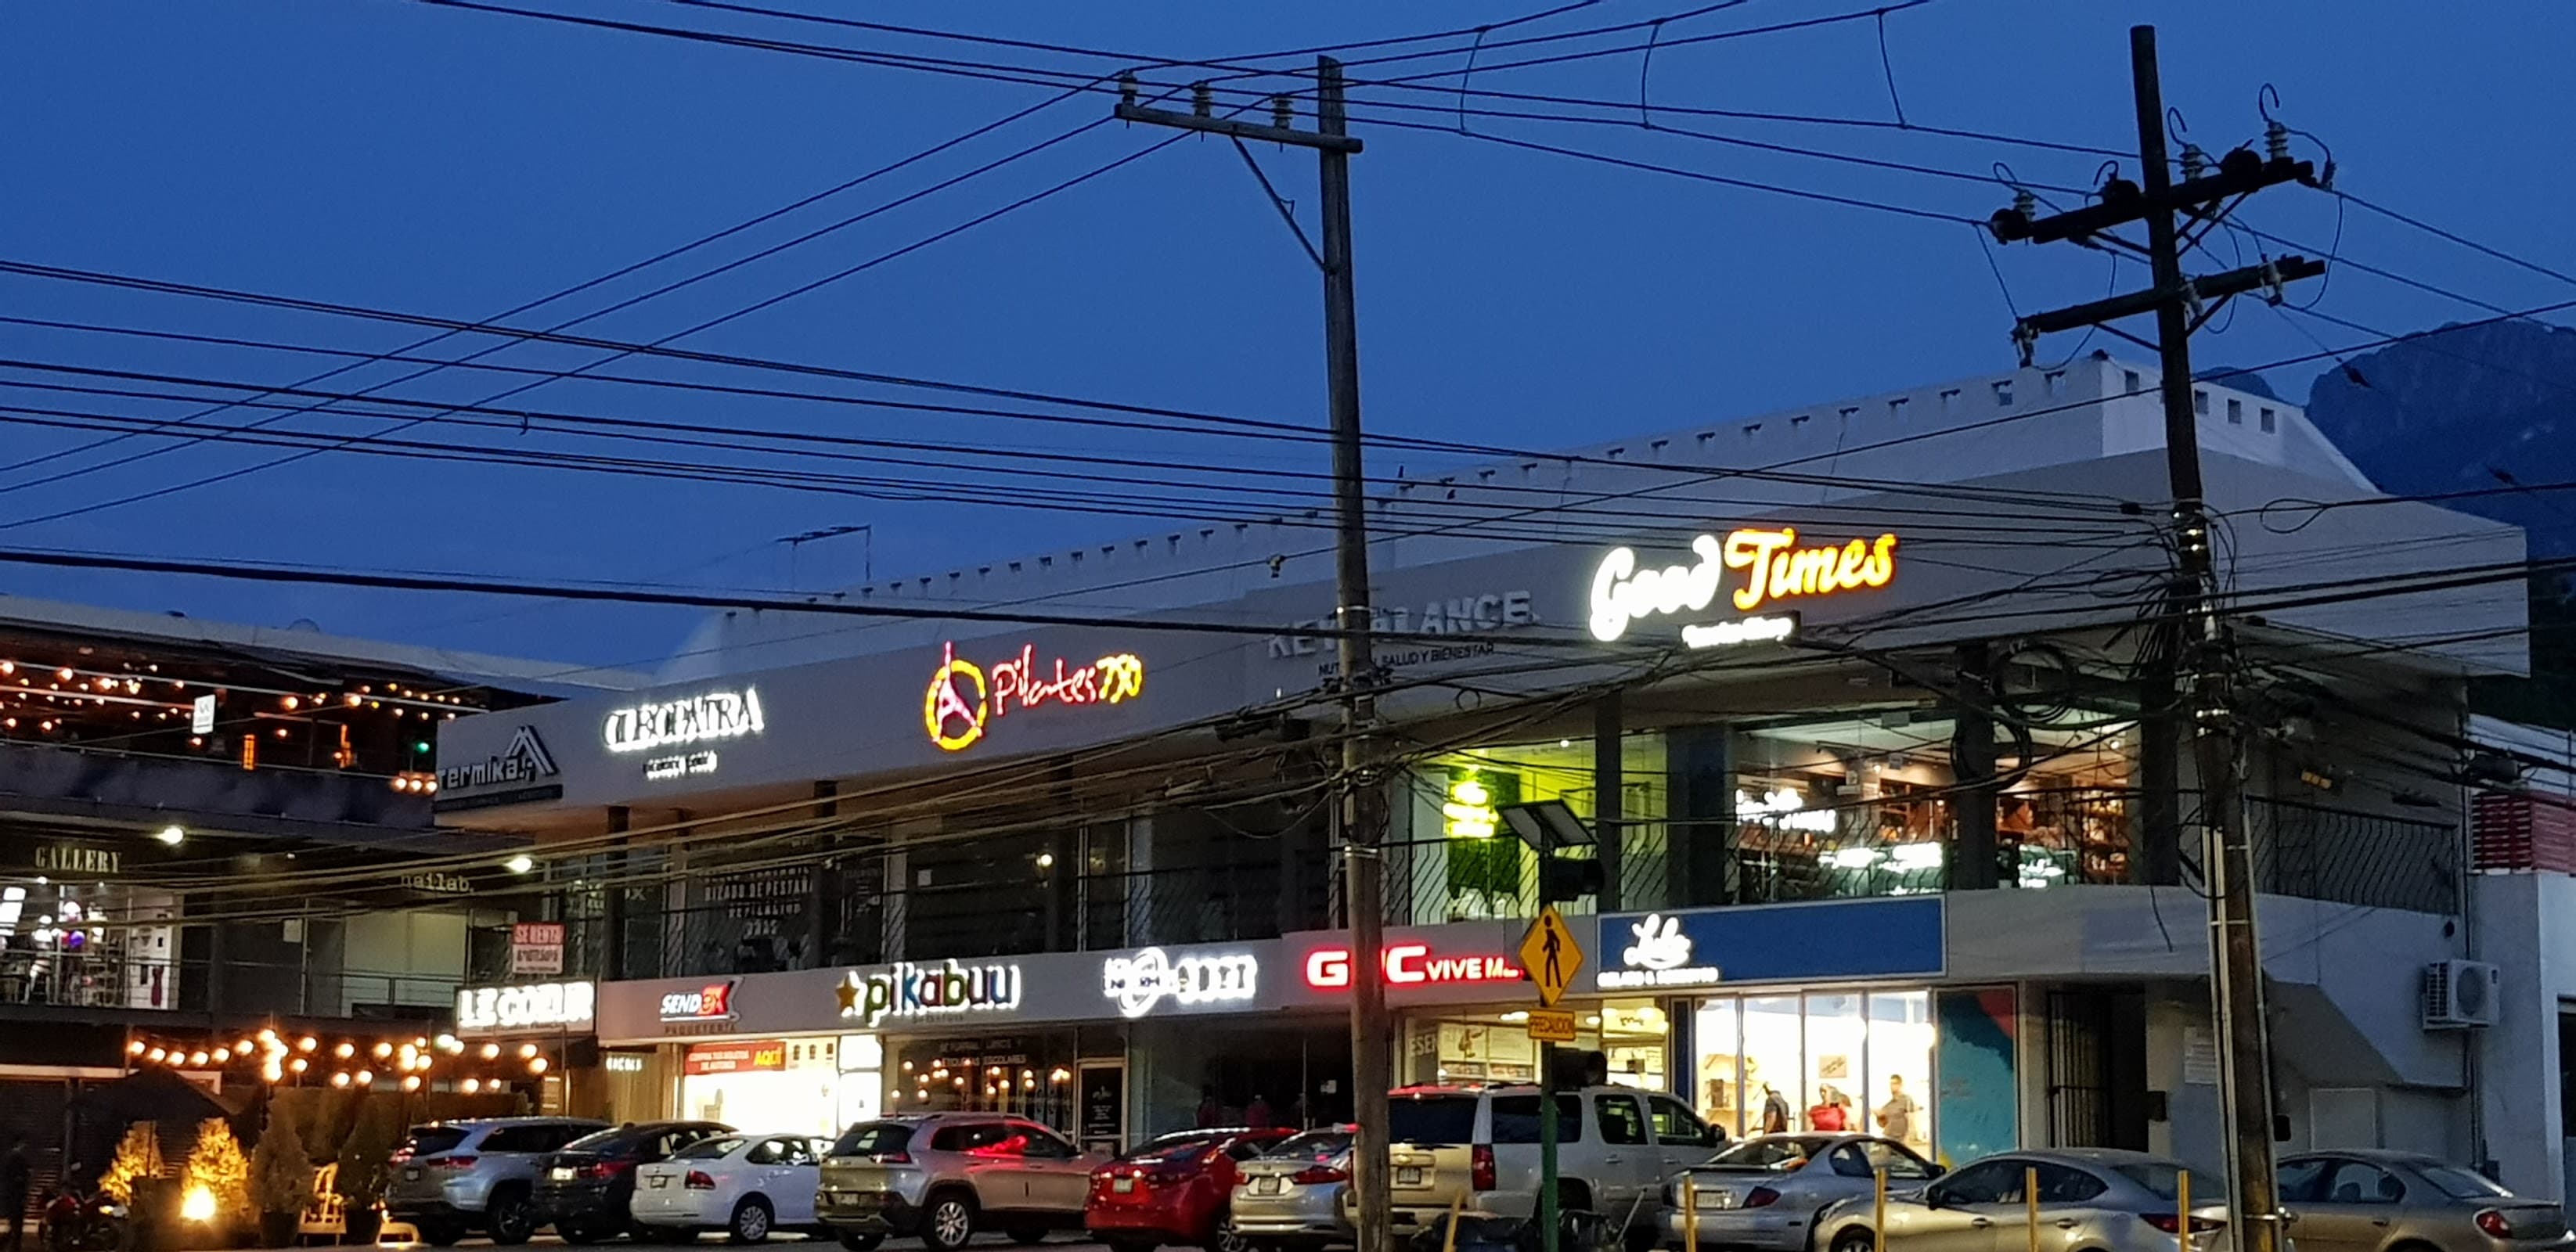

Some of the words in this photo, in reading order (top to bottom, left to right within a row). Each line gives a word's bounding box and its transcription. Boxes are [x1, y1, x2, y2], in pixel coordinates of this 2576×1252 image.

[1590, 534, 1720, 642] Good
[1724, 527, 1897, 610] Times
[35, 846, 121, 873] GALLERY
[1426, 958, 1482, 980] VIVE
[863, 959, 1020, 1027] pikabuu
